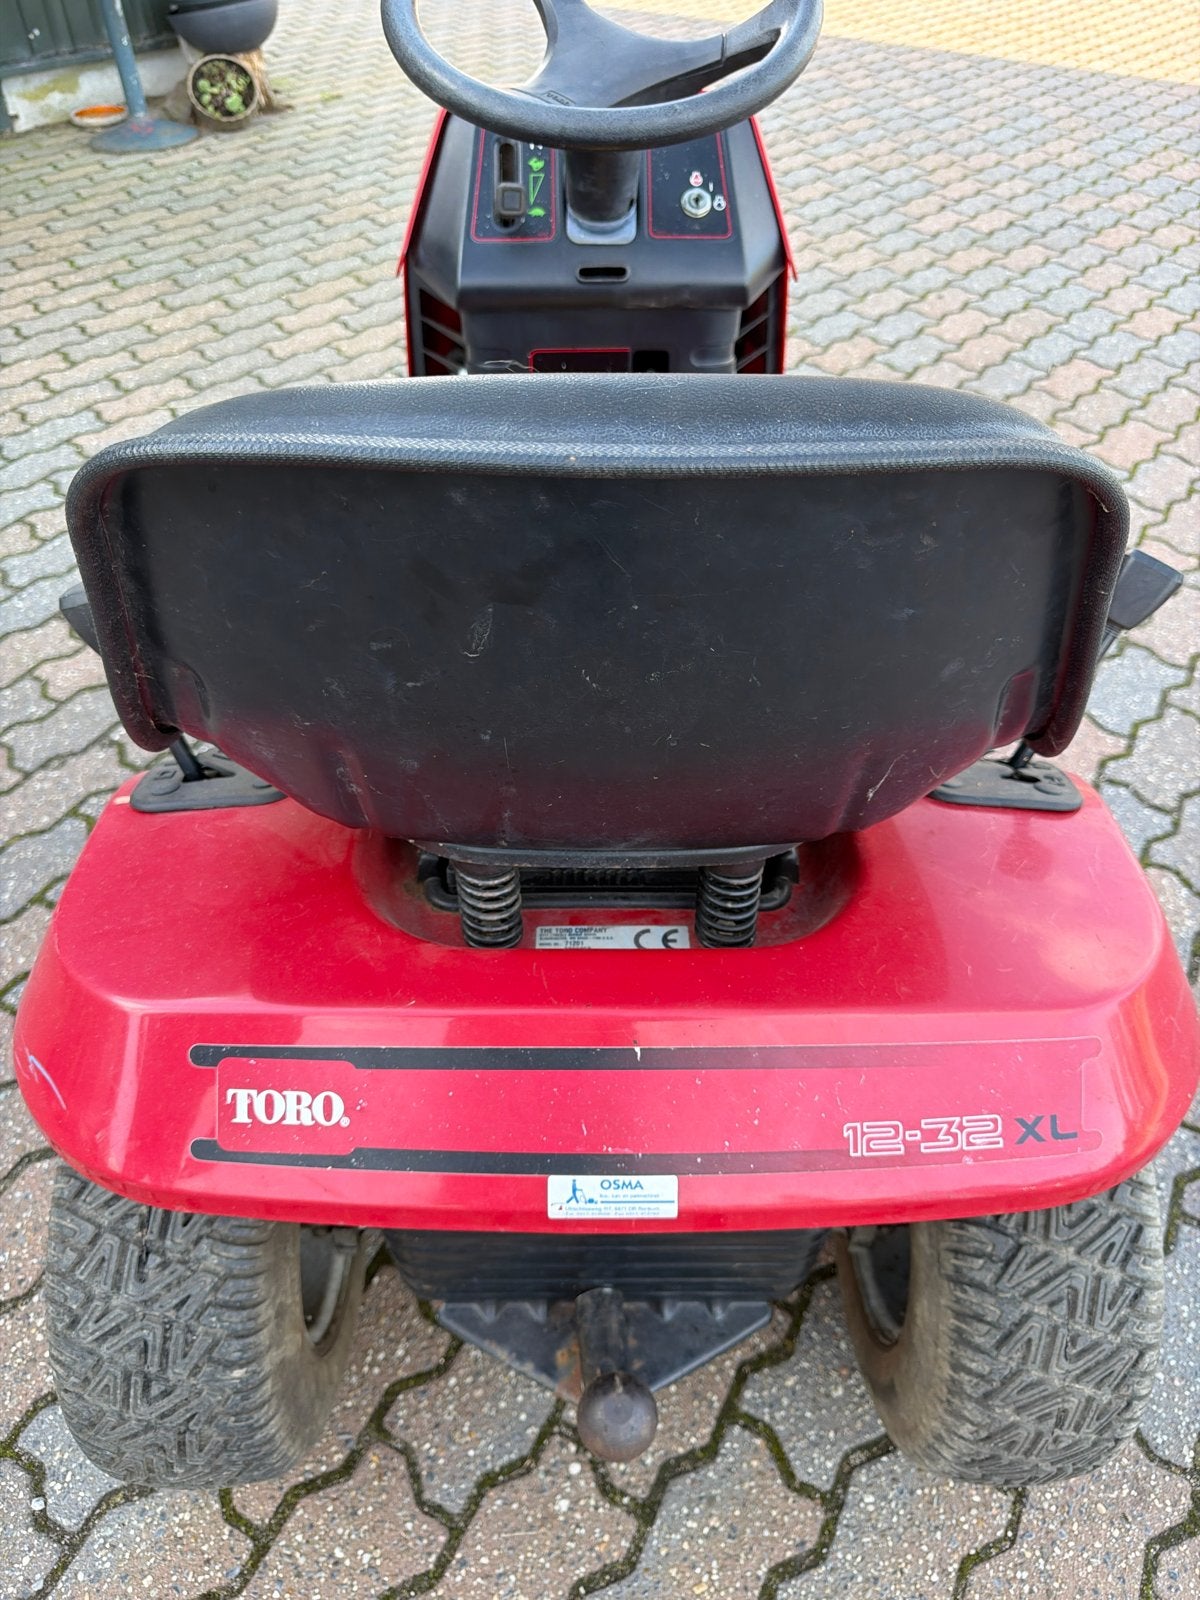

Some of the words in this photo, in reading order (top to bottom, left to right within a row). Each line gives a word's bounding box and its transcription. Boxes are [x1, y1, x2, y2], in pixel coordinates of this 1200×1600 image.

[225, 1088, 345, 1127] TORO
[842, 1114, 1004, 1158] 12-32
[1014, 1114, 1078, 1145] XL
[600, 1179, 644, 1190] OSMA
